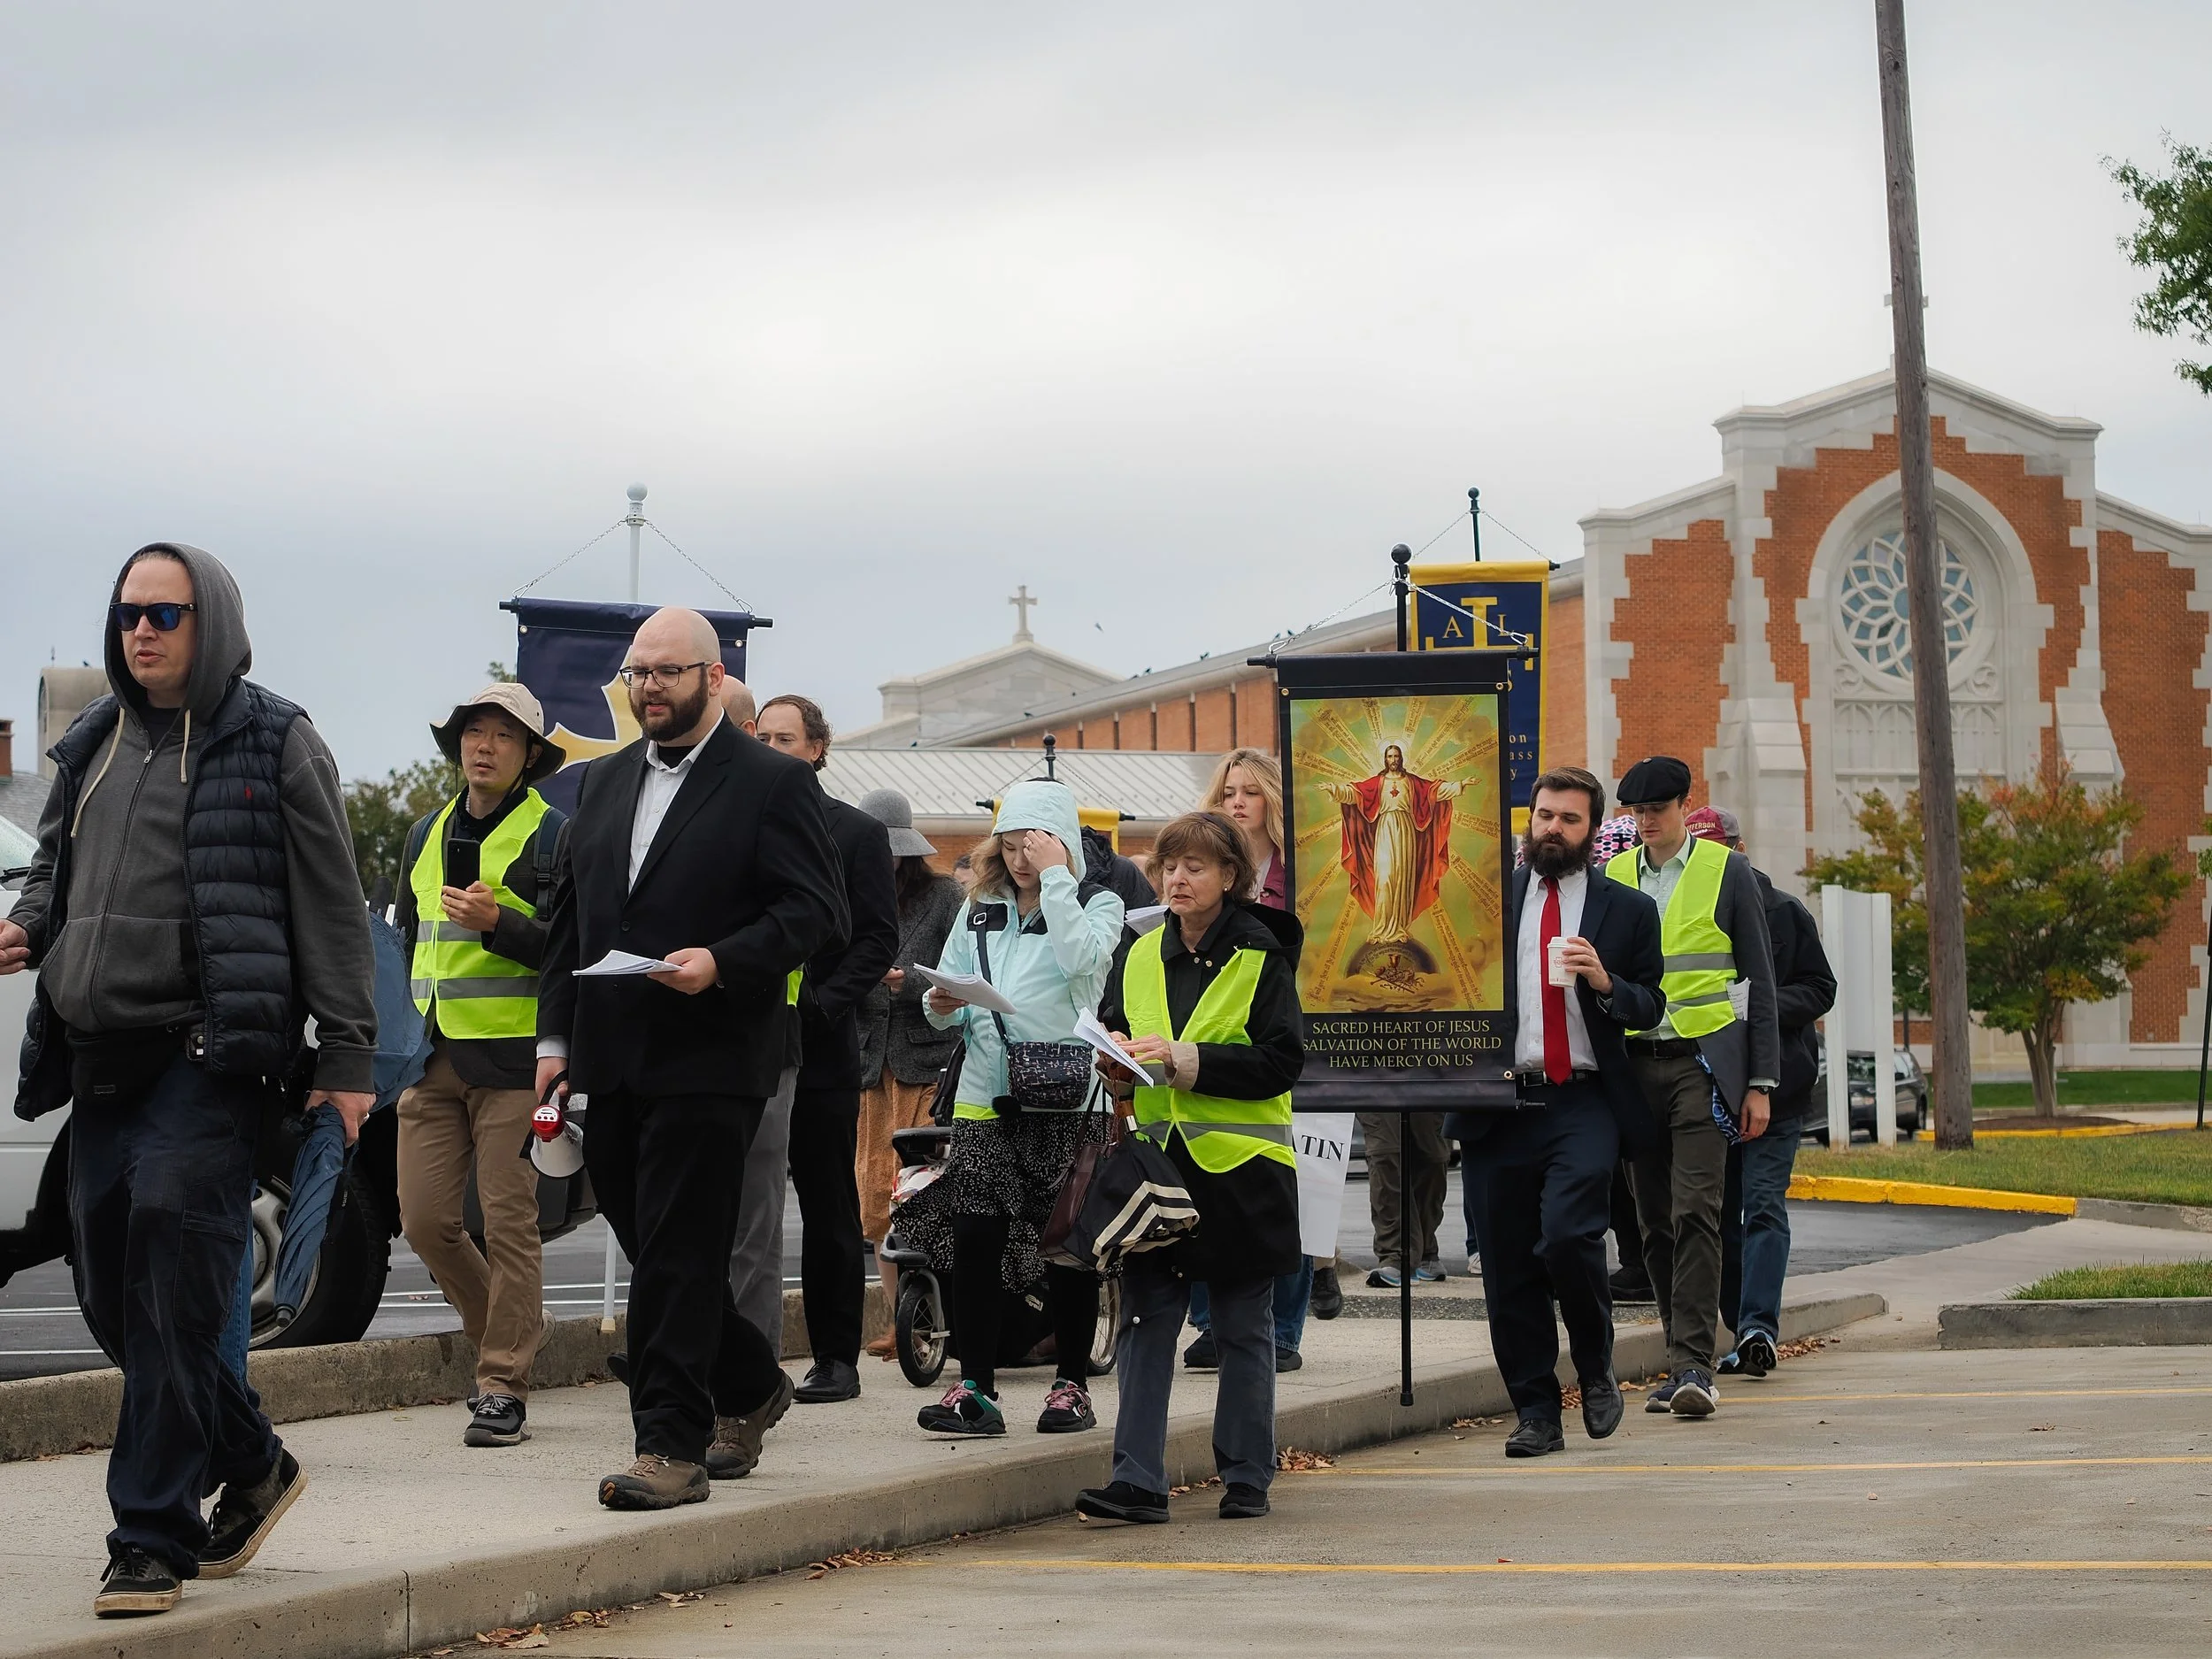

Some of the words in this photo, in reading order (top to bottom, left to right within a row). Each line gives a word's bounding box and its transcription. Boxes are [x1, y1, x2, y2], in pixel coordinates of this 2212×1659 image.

[1441, 615, 1464, 639] A
[1509, 733, 1527, 744] on
[1509, 751, 1533, 761] ass
[1312, 1022, 1369, 1034] SACRED
[1372, 1021, 1422, 1034] HEART
[1425, 1020, 1446, 1033] OF
[1448, 1019, 1490, 1035] JESUS
[1303, 1038, 1384, 1051] SALVATION
[1387, 1038, 1408, 1051] OF
[1410, 1037, 1441, 1050] THE
[1445, 1036, 1502, 1049] WORLD
[1329, 1056, 1370, 1068] HAVE
[1373, 1055, 1424, 1068] MERCY
[1427, 1054, 1451, 1067] ON
[1454, 1054, 1474, 1067] US
